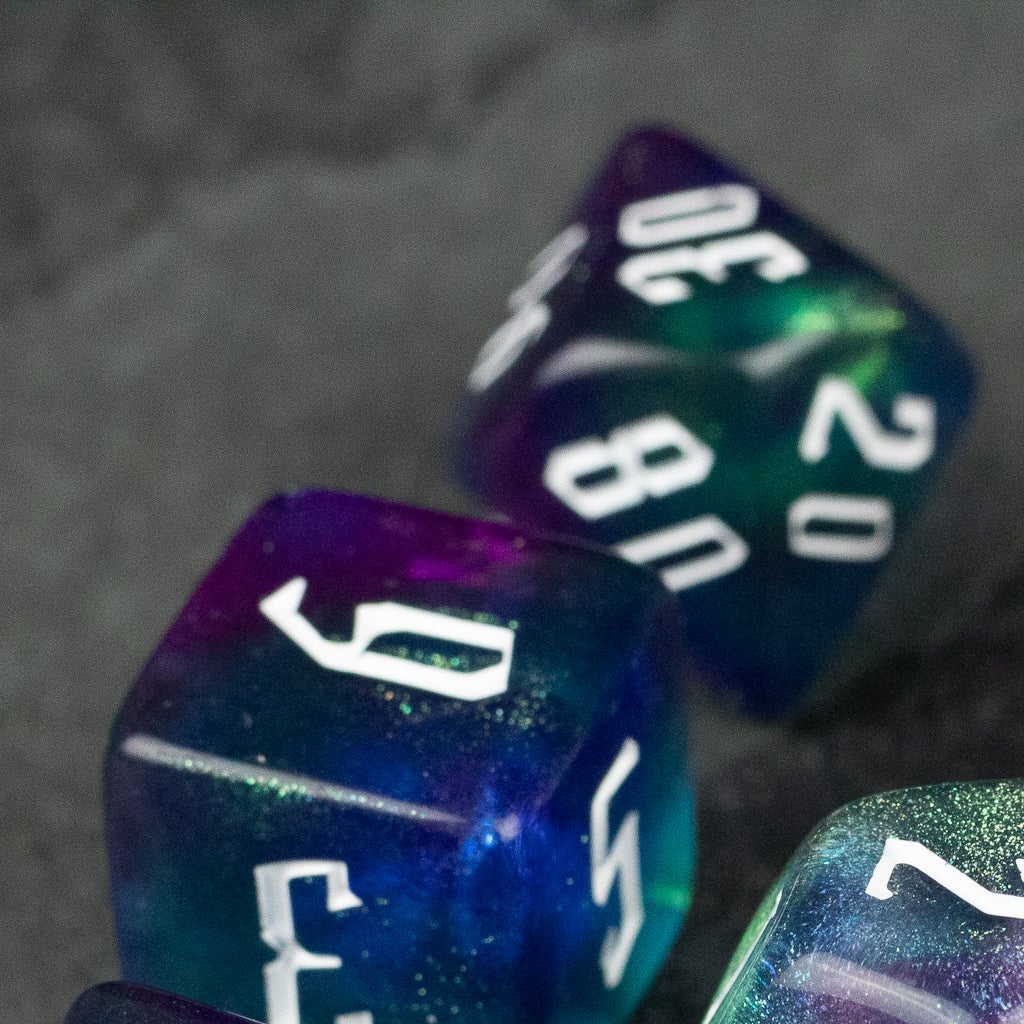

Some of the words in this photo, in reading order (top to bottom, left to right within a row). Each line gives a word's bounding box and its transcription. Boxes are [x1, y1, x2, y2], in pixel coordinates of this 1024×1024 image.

[616, 183, 809, 306] 30
[788, 377, 938, 562] 20
[259, 575, 516, 702] 6
[590, 738, 644, 988] 5
